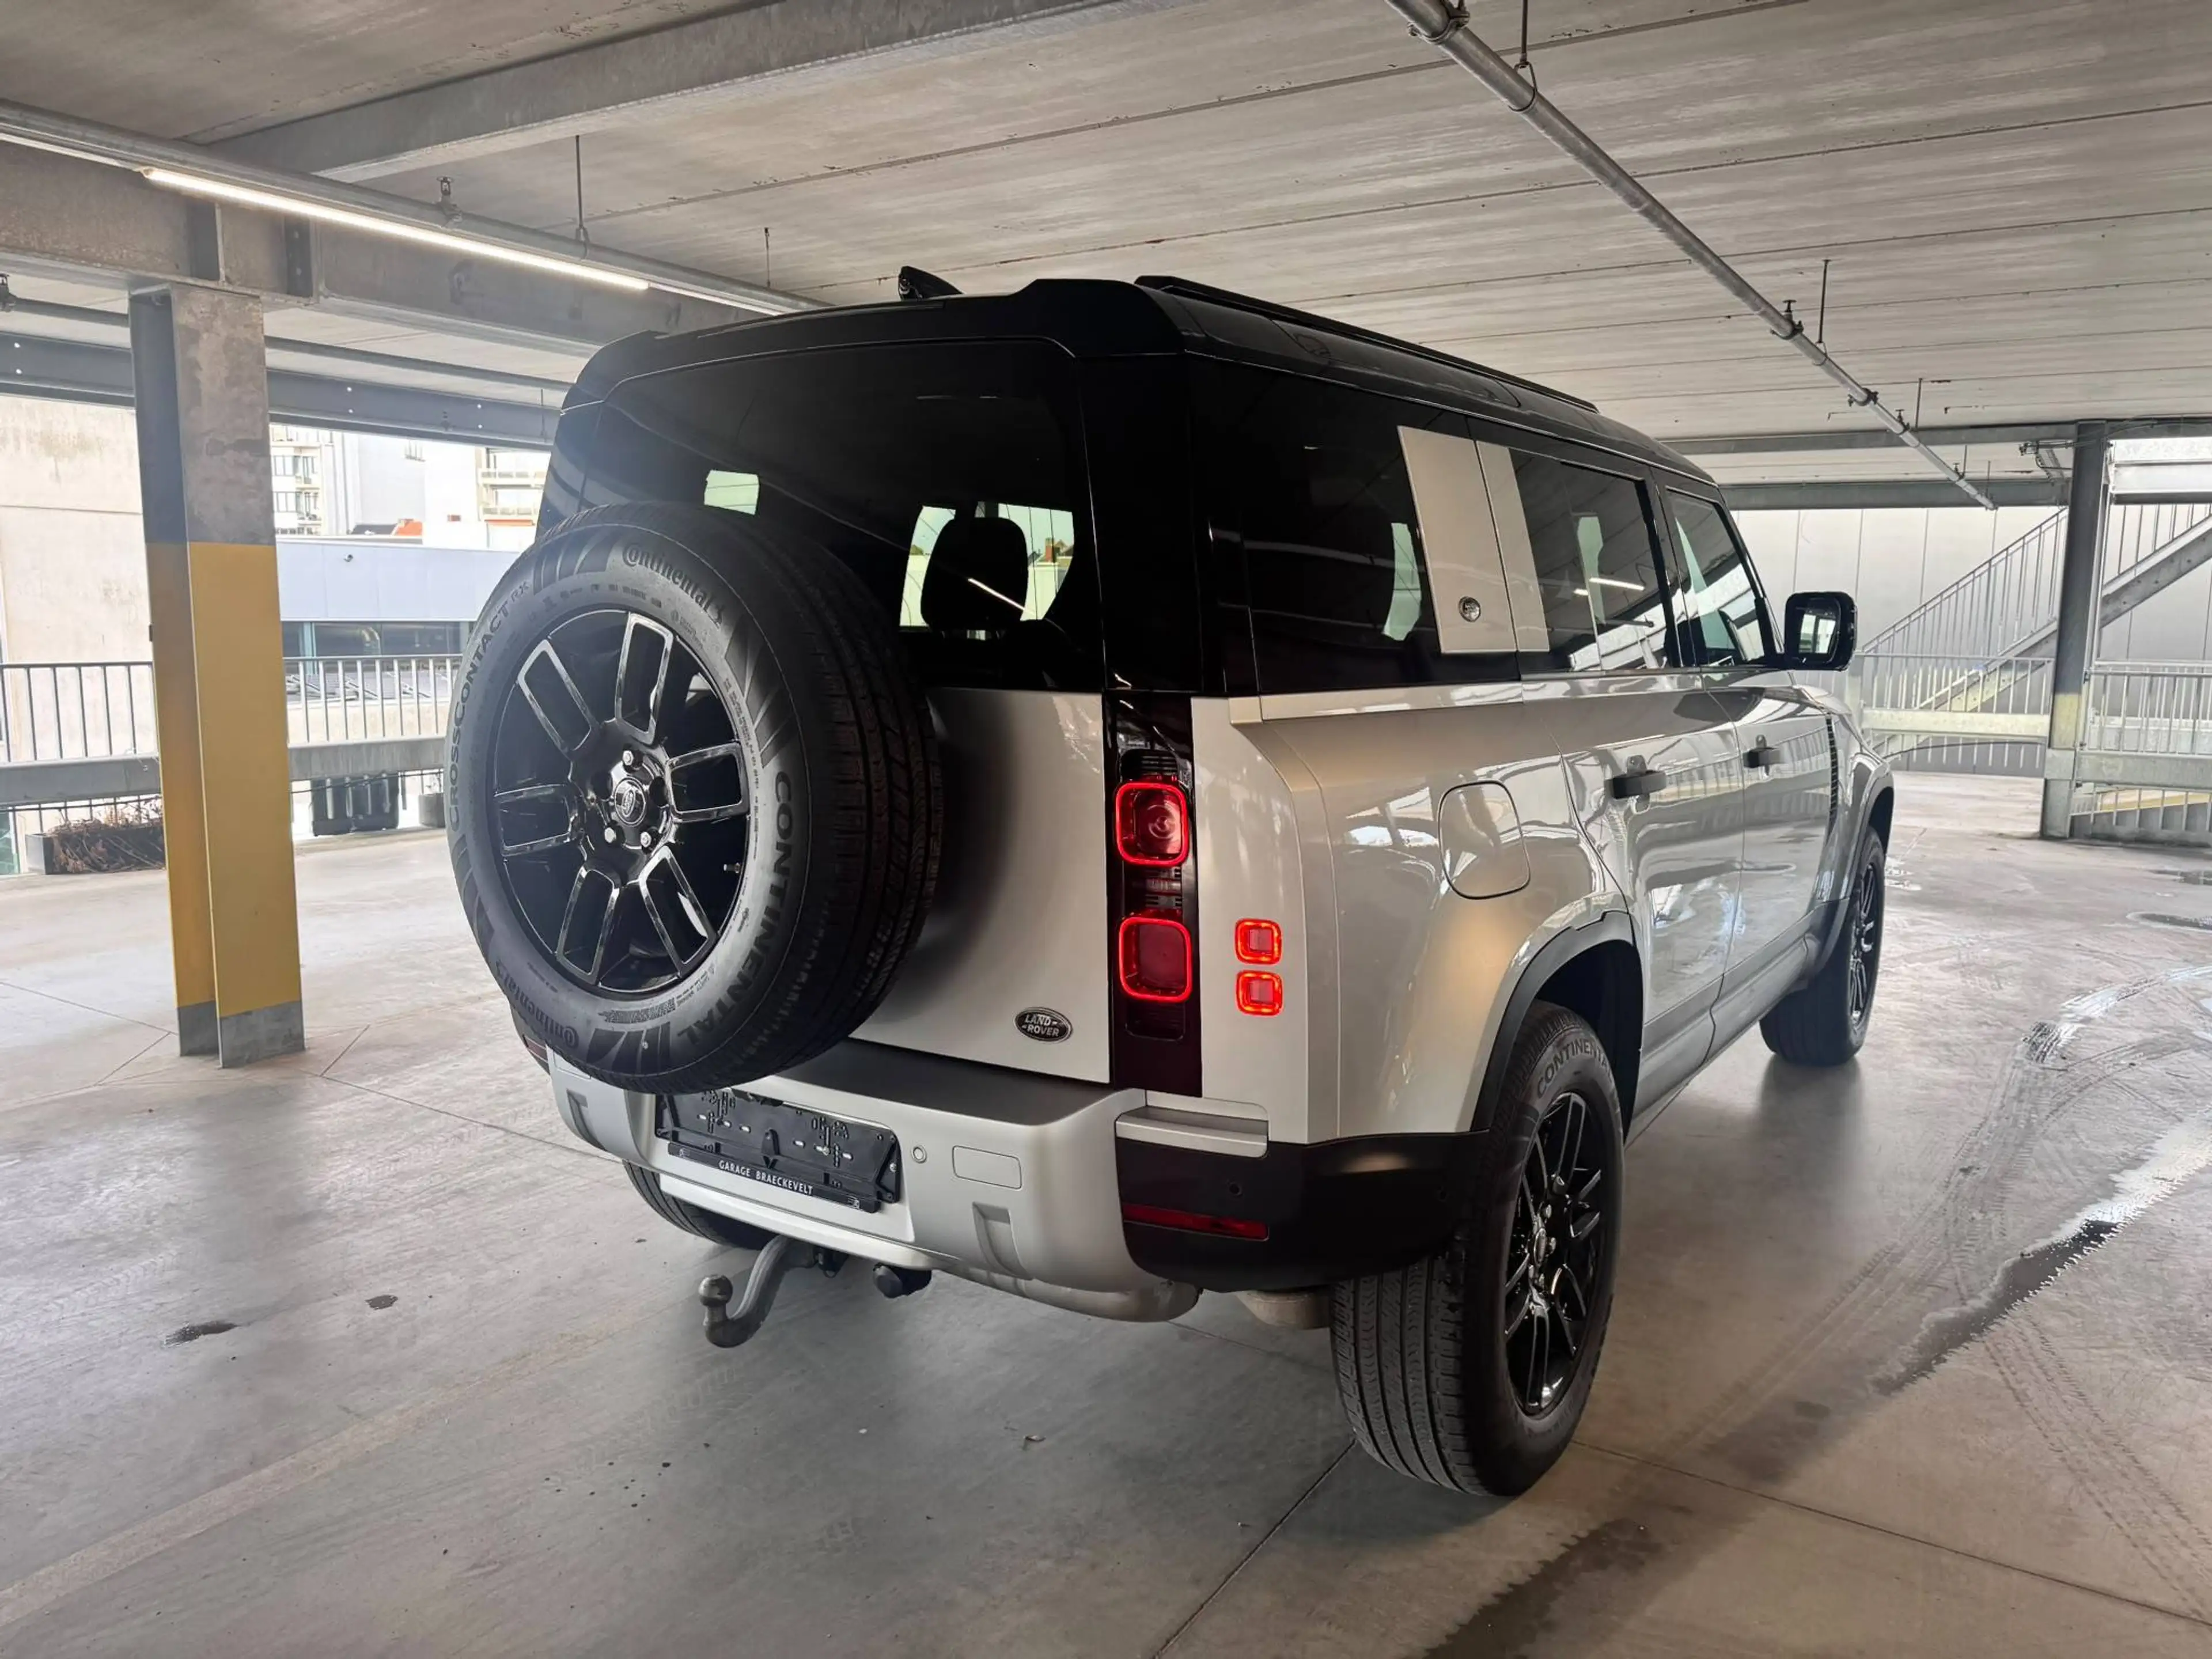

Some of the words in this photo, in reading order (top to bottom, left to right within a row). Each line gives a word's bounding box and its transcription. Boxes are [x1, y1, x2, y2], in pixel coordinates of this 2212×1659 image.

[623, 544, 716, 613] Continental
[678, 771, 793, 1044] CONTINENTAL
[1025, 1014, 1051, 1026] LAND
[1027, 1025, 1059, 1036] ROVER
[719, 1160, 750, 1176] GARAGE
[756, 1171, 813, 1195] BRAECKEVELT
